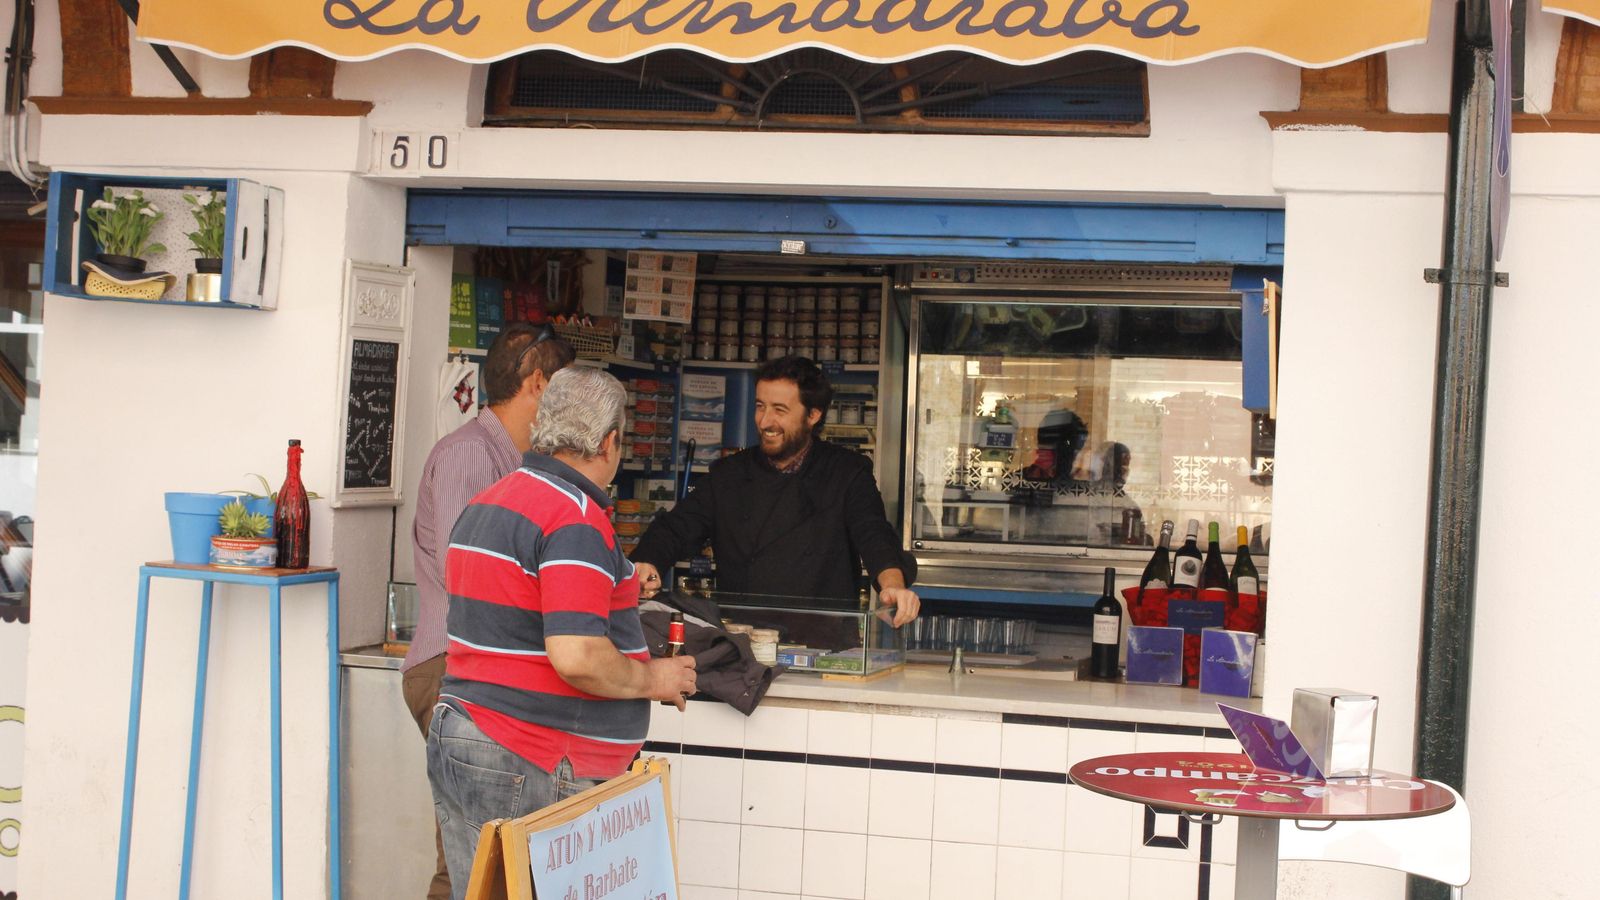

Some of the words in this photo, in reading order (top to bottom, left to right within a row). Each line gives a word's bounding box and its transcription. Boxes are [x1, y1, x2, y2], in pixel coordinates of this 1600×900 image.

[353, 342, 395, 359] ALMADRABA
[545, 823, 585, 874] ATÚN
[587, 820, 596, 853] Y
[600, 795, 652, 847] MOJAMA
[584, 855, 638, 900] Barbate
